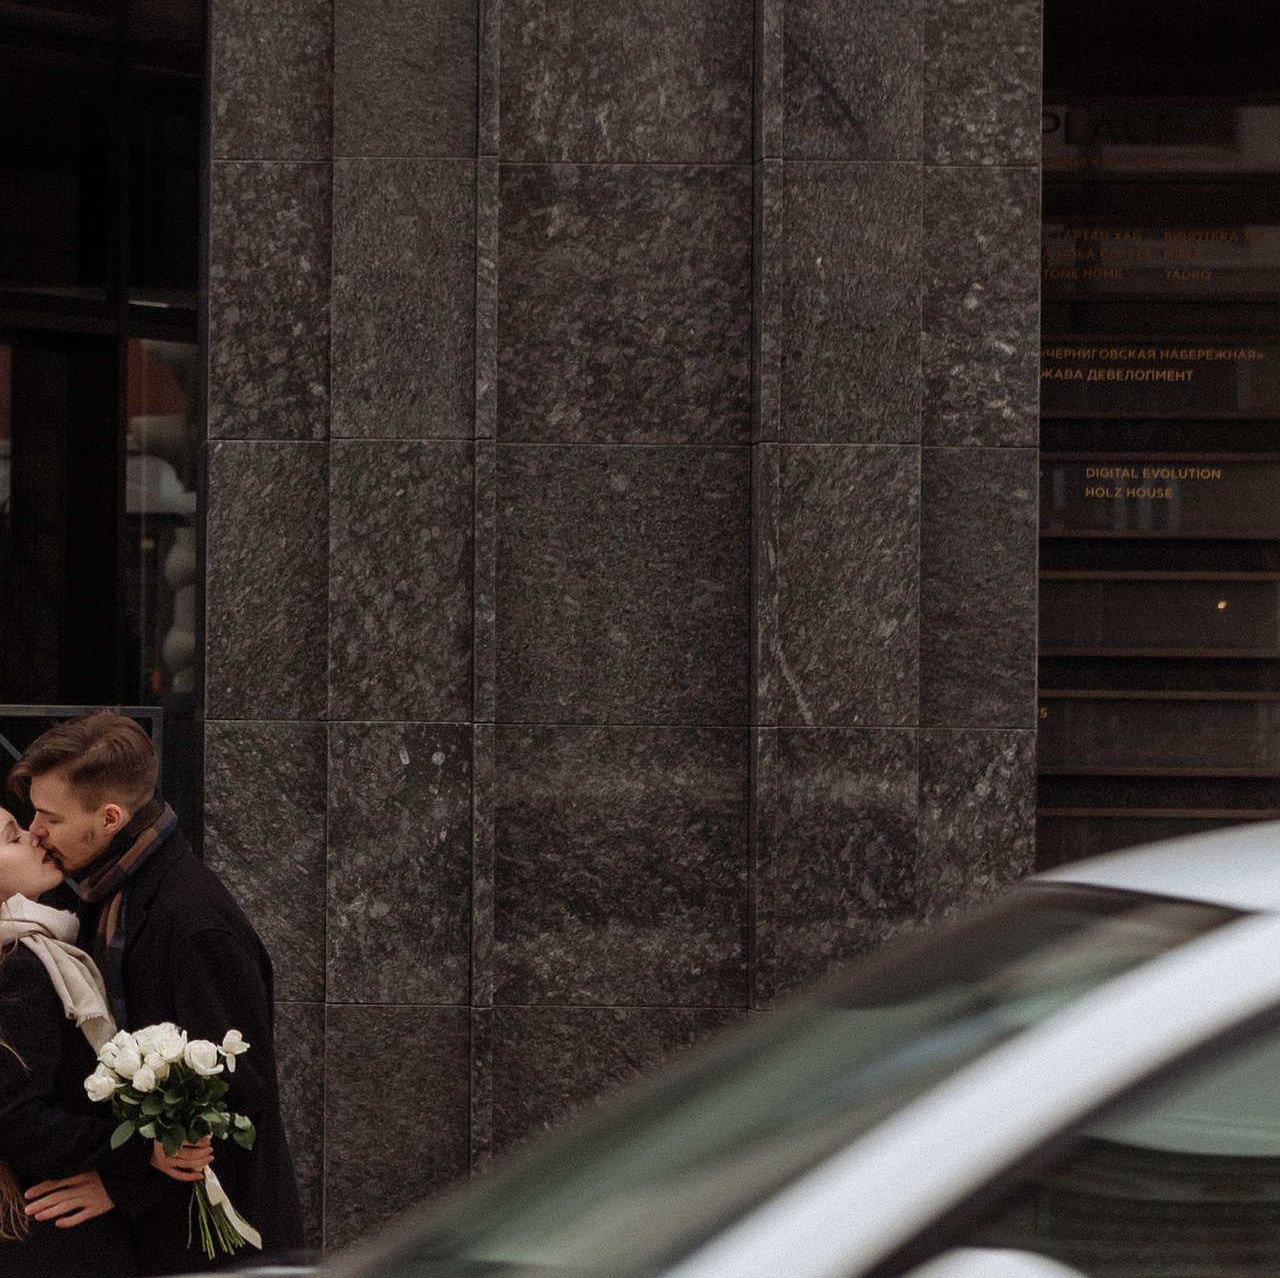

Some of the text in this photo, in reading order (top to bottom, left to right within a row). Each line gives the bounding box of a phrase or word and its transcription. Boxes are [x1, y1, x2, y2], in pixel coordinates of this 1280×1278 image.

[1160, 348, 1264, 360] НАБЕРЕЖНАЯ»
[1087, 369, 1193, 381] ДЕВЕЛОПМЕНТ
[1085, 467, 1221, 479] DIGITAL EVOLUTION
[1085, 487, 1174, 498] HOLZ HOUSE
